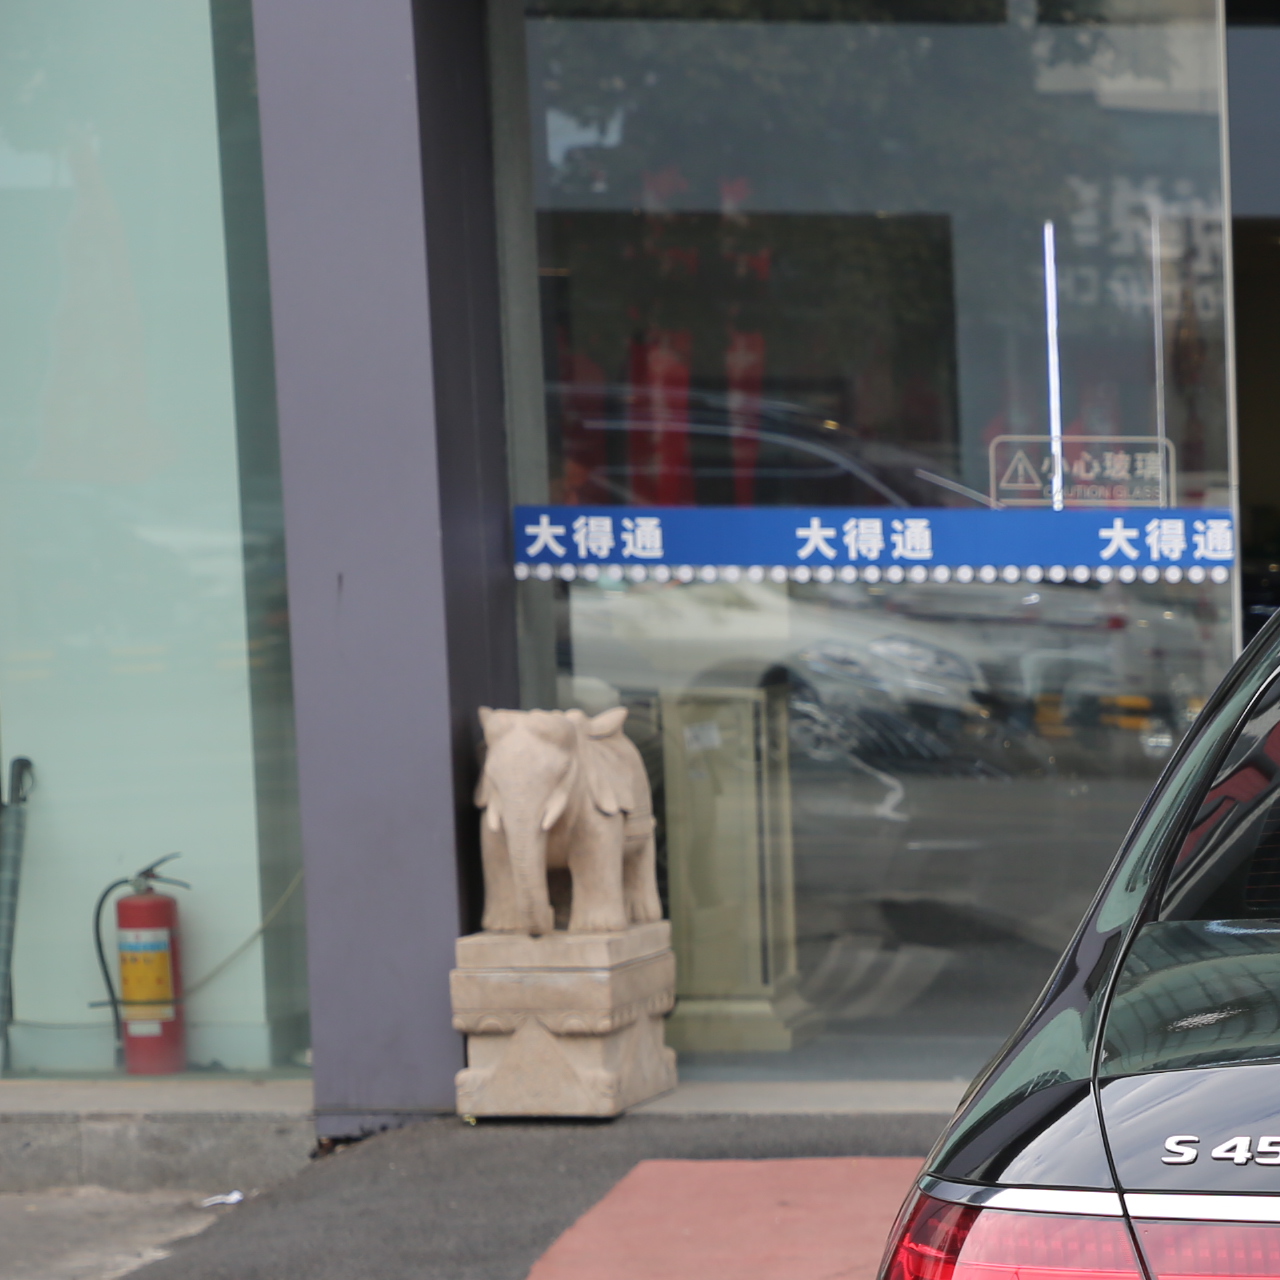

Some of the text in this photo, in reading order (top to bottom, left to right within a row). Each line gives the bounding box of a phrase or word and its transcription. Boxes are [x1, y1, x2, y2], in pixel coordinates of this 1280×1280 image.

[1043, 485, 1111, 499] CUTION
[524, 514, 664, 559] 大得通
[796, 517, 933, 560] 大得通
[1099, 517, 1235, 561] 大得通
[1161, 1134, 1200, 1165] S
